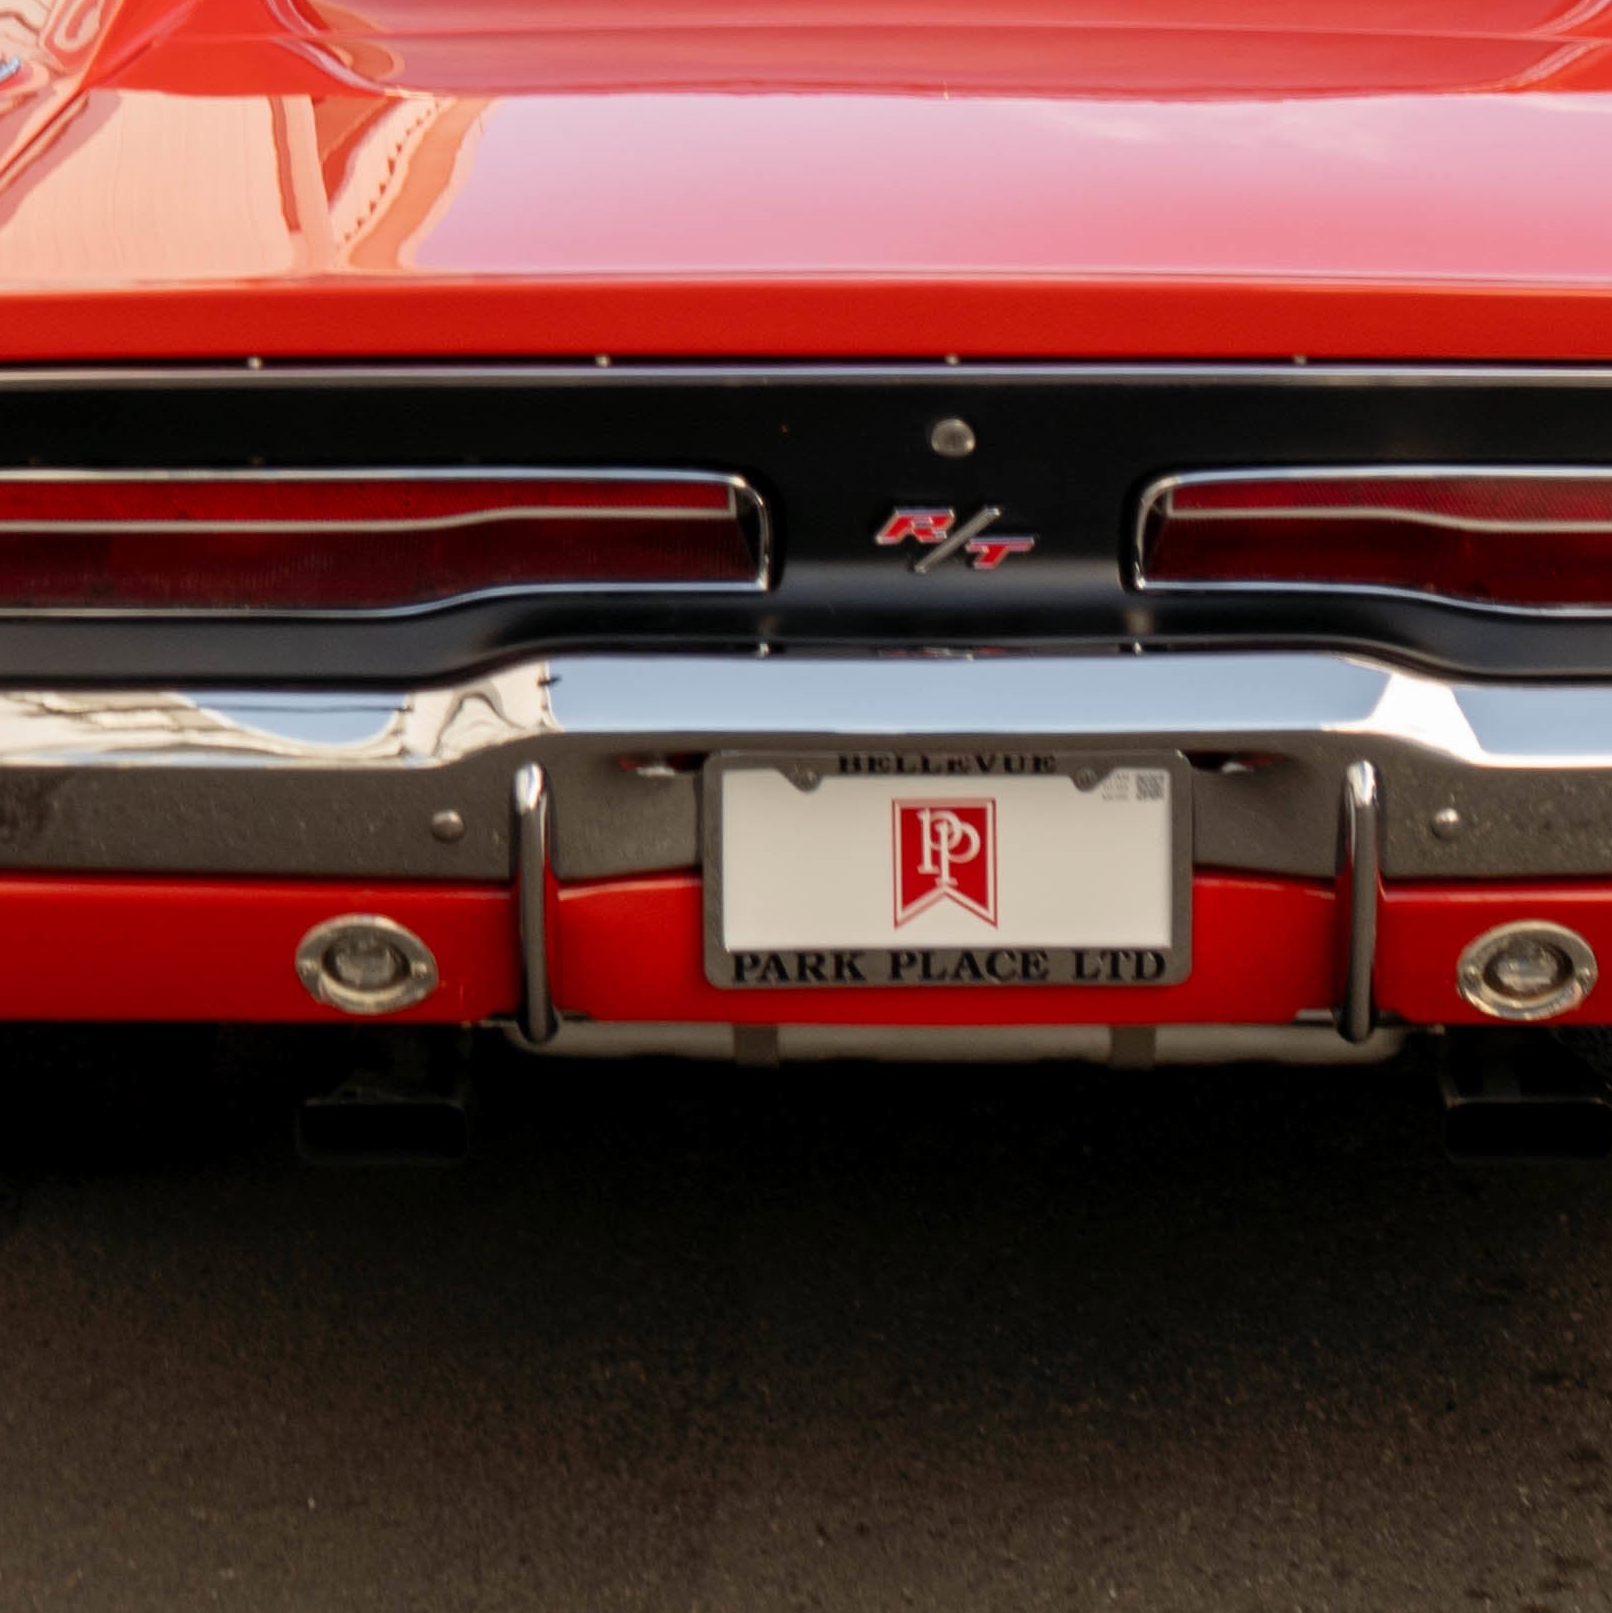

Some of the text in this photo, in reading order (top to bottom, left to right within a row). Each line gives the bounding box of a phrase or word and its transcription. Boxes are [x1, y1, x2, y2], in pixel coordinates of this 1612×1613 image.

[875, 506, 1035, 573] R/T
[733, 949, 1166, 982] PARK PLACE LTD
